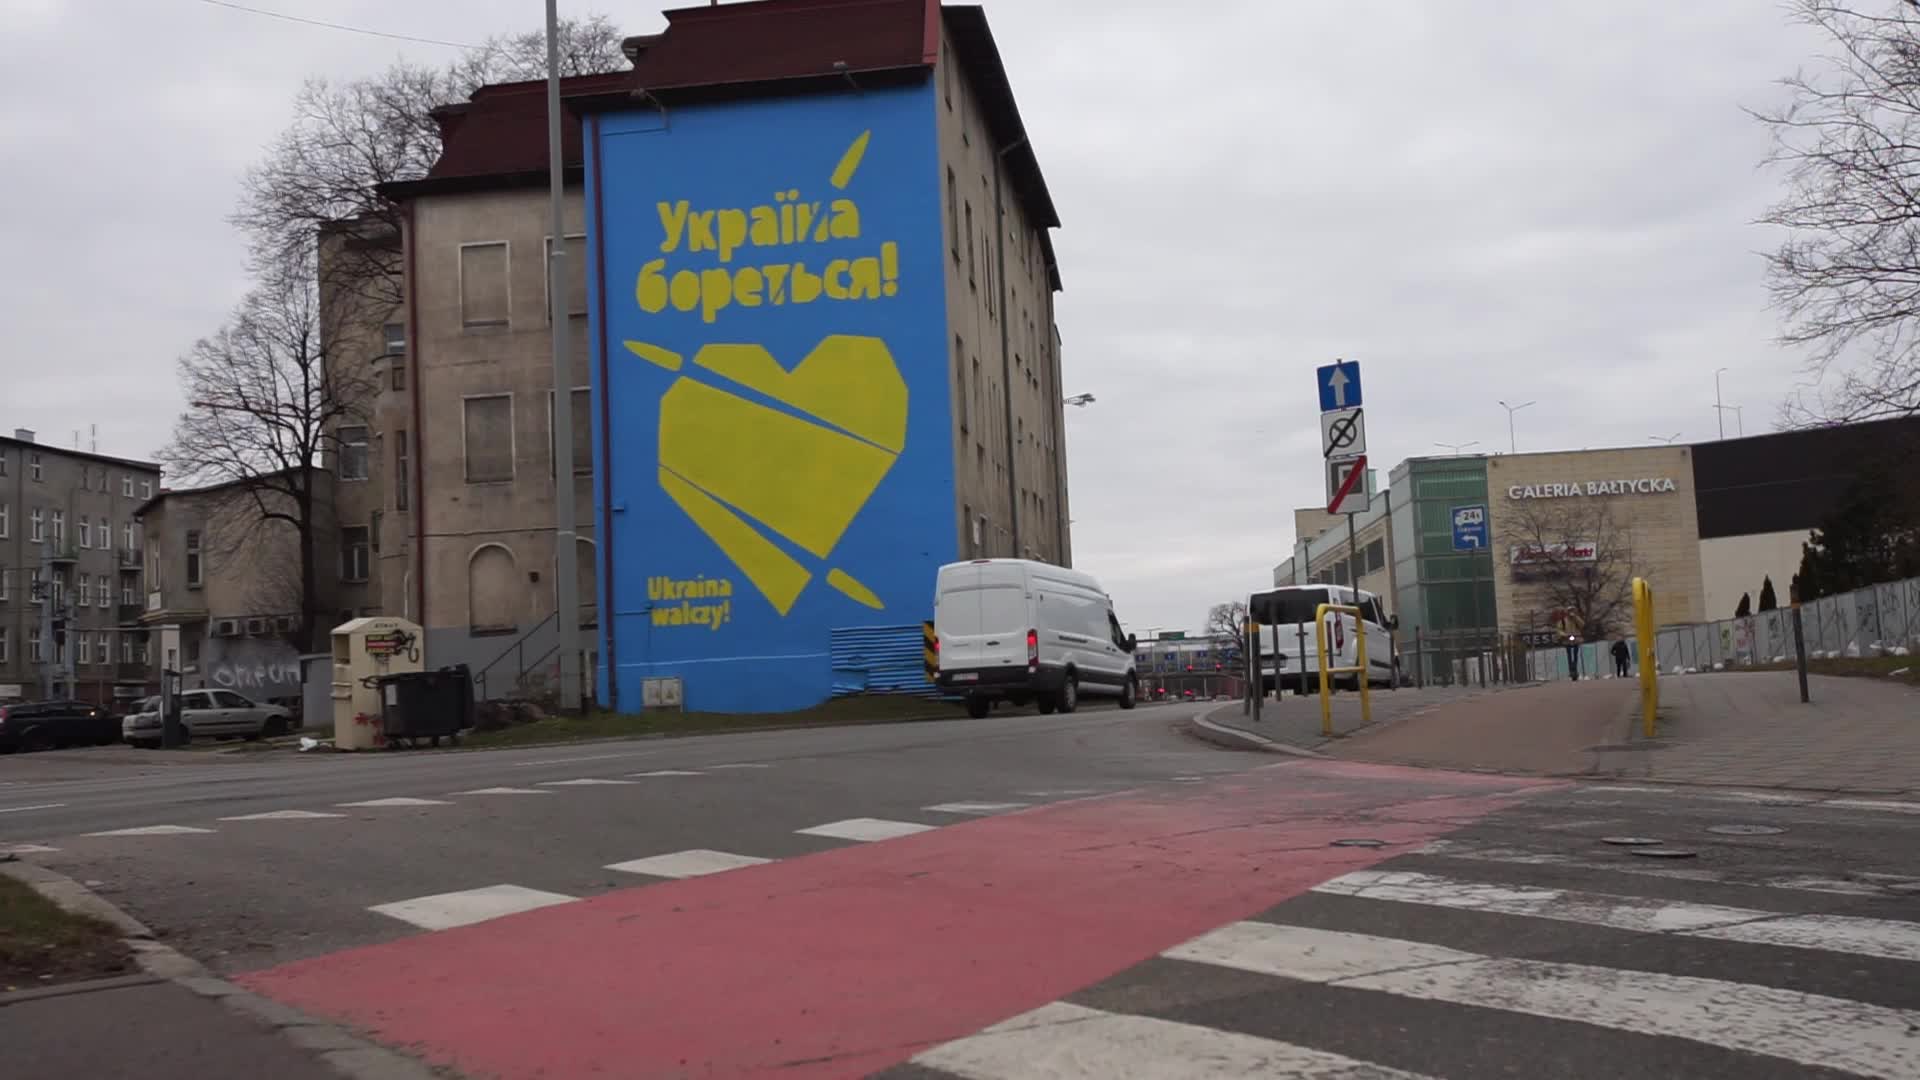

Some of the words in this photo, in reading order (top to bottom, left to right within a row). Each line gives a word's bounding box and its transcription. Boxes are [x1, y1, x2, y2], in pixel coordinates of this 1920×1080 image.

[656, 189, 860, 262] Україна
[636, 241, 898, 323] бореться!
[1509, 482, 1582, 499] GALERIA
[1587, 478, 1676, 495] BAŁTYCKA
[647, 575, 732, 600] Ukraina
[652, 600, 730, 630] walczy!
